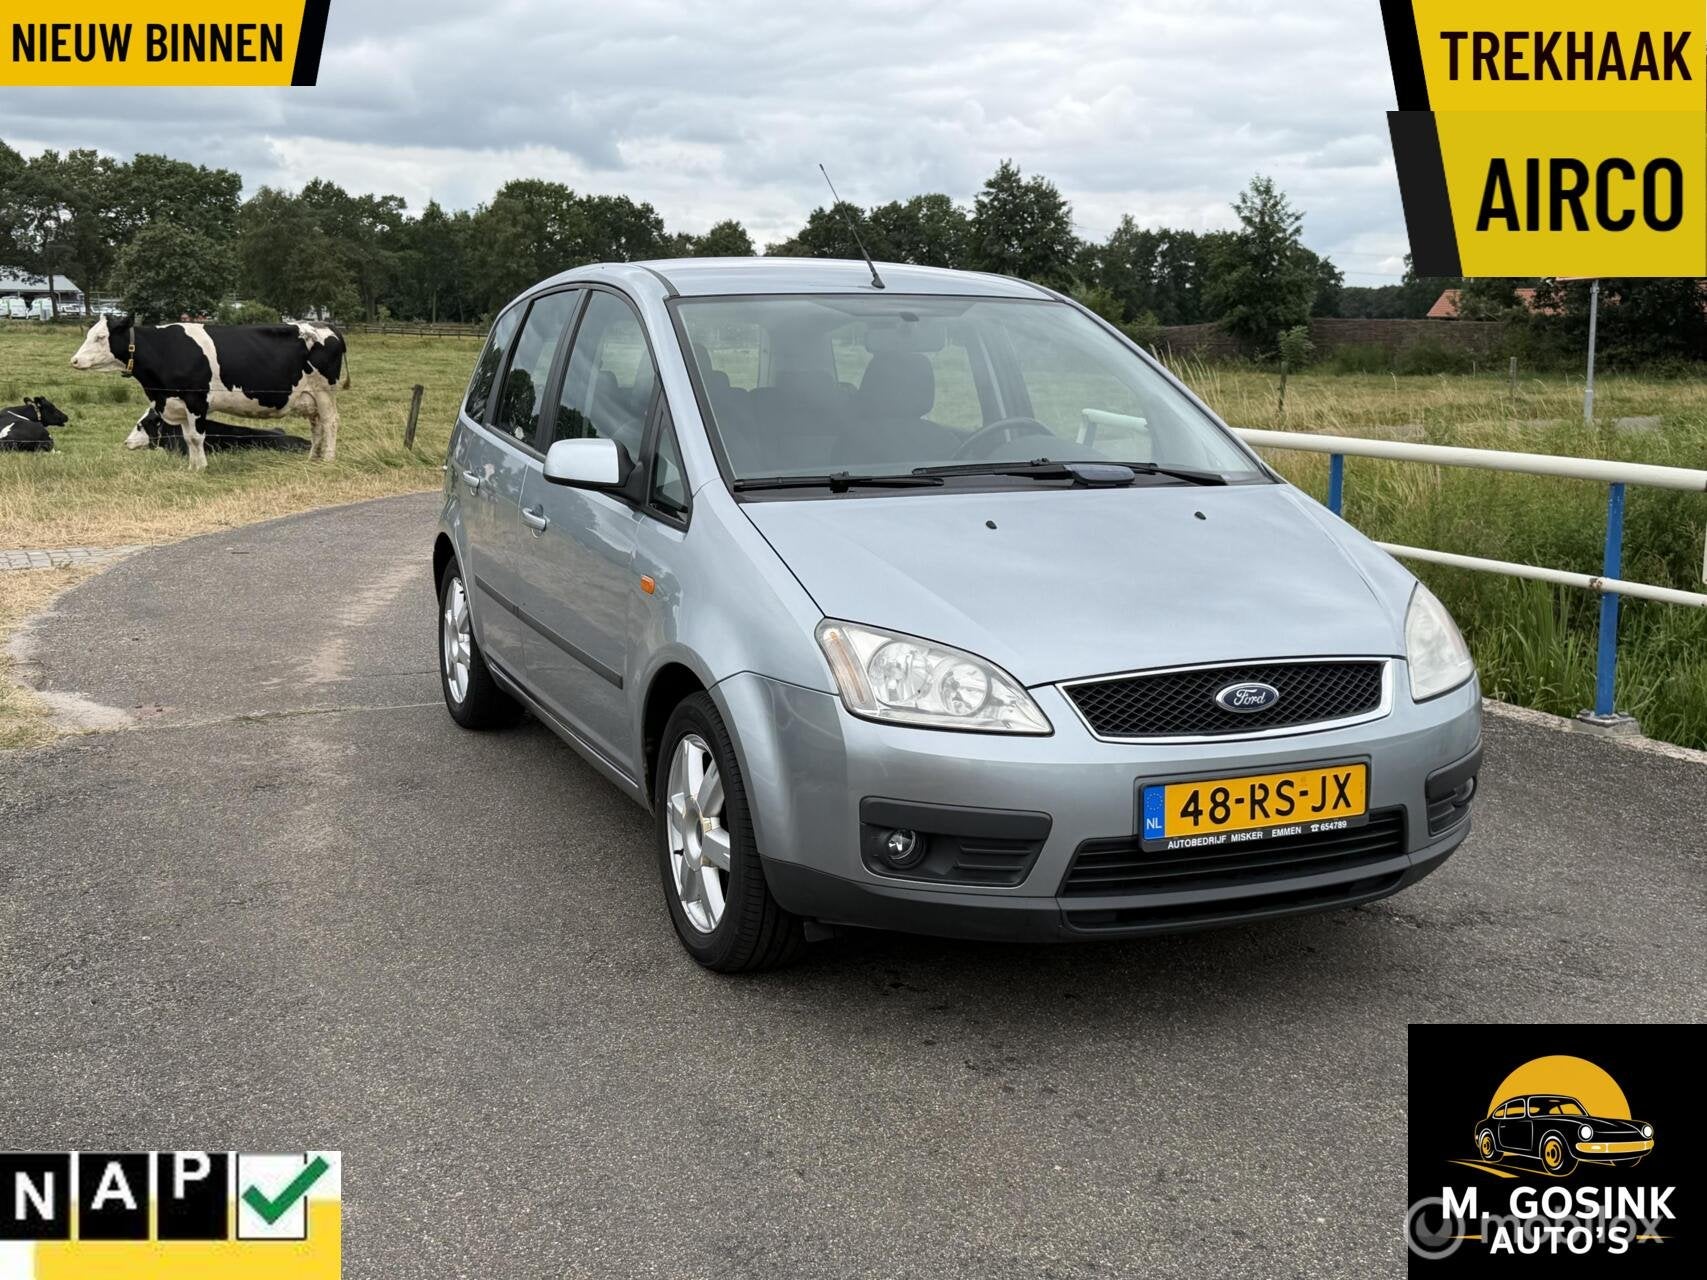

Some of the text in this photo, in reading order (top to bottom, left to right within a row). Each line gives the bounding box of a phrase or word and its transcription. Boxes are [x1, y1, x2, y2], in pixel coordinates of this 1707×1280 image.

[1233, 688, 1266, 706] Ford
[1180, 772, 1352, 826] 48-RS-JX
[1146, 818, 1162, 830] NL
[1167, 835, 1227, 849] AUTOBEDRIJF
[1230, 831, 1263, 842] MISKER
[1271, 826, 1302, 838] EMMEN
